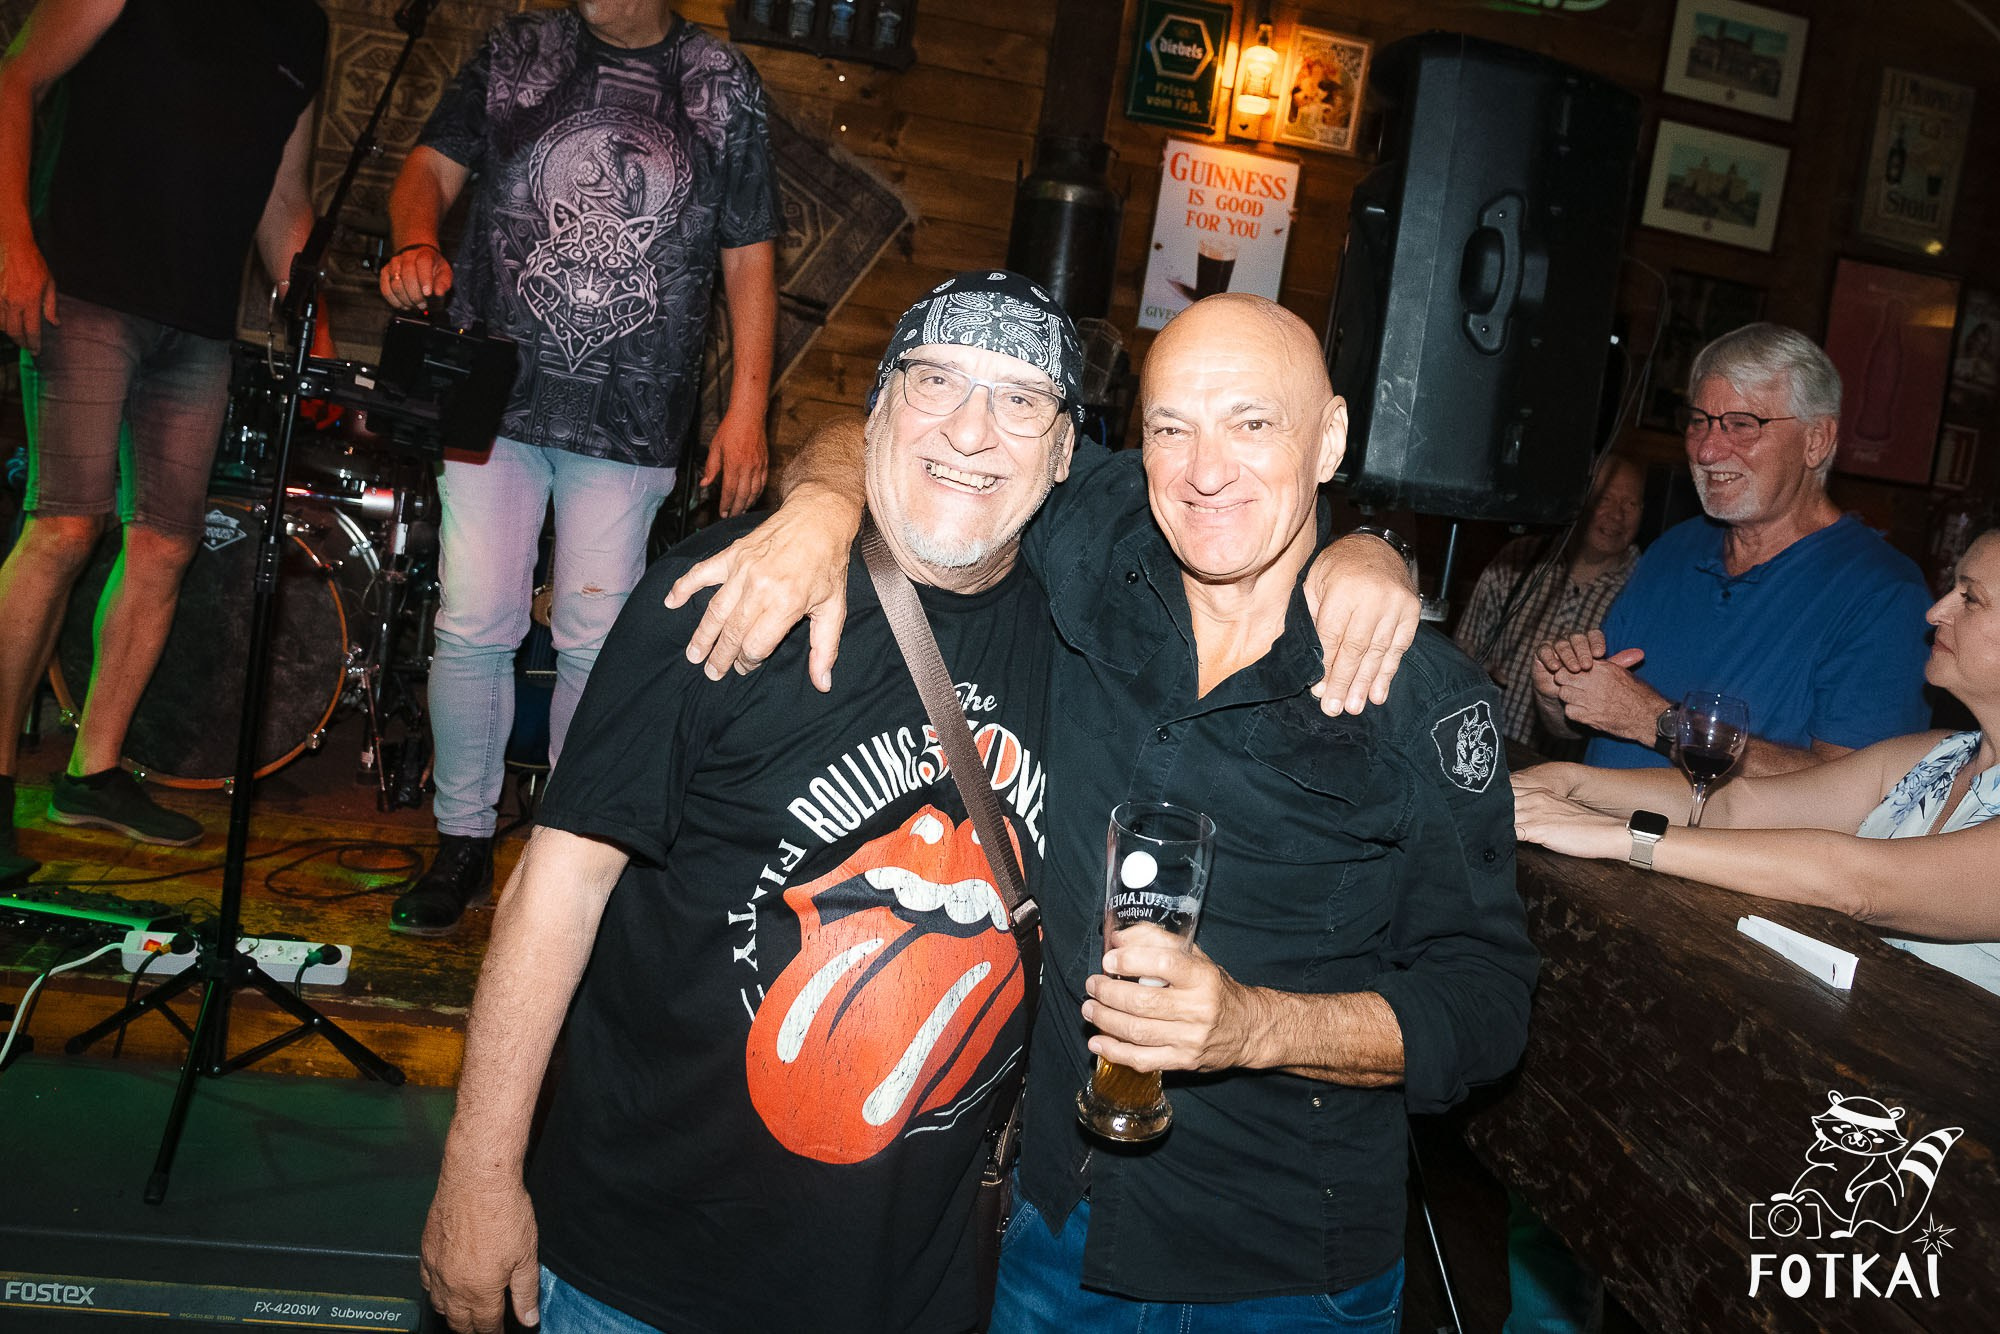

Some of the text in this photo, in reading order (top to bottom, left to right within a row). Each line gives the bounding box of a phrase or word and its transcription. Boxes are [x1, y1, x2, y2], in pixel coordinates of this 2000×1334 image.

[1145, 95, 1172, 108] vom
[1155, 82, 1195, 99] Frisch
[1171, 152, 1286, 200] GUINNESS
[1188, 189, 1264, 217] IS GOOD
[1185, 210, 1261, 240] FOR YOU
[787, 726, 922, 844] ROLLING
[253, 1300, 402, 1323] FX-420SW Subwoofer
